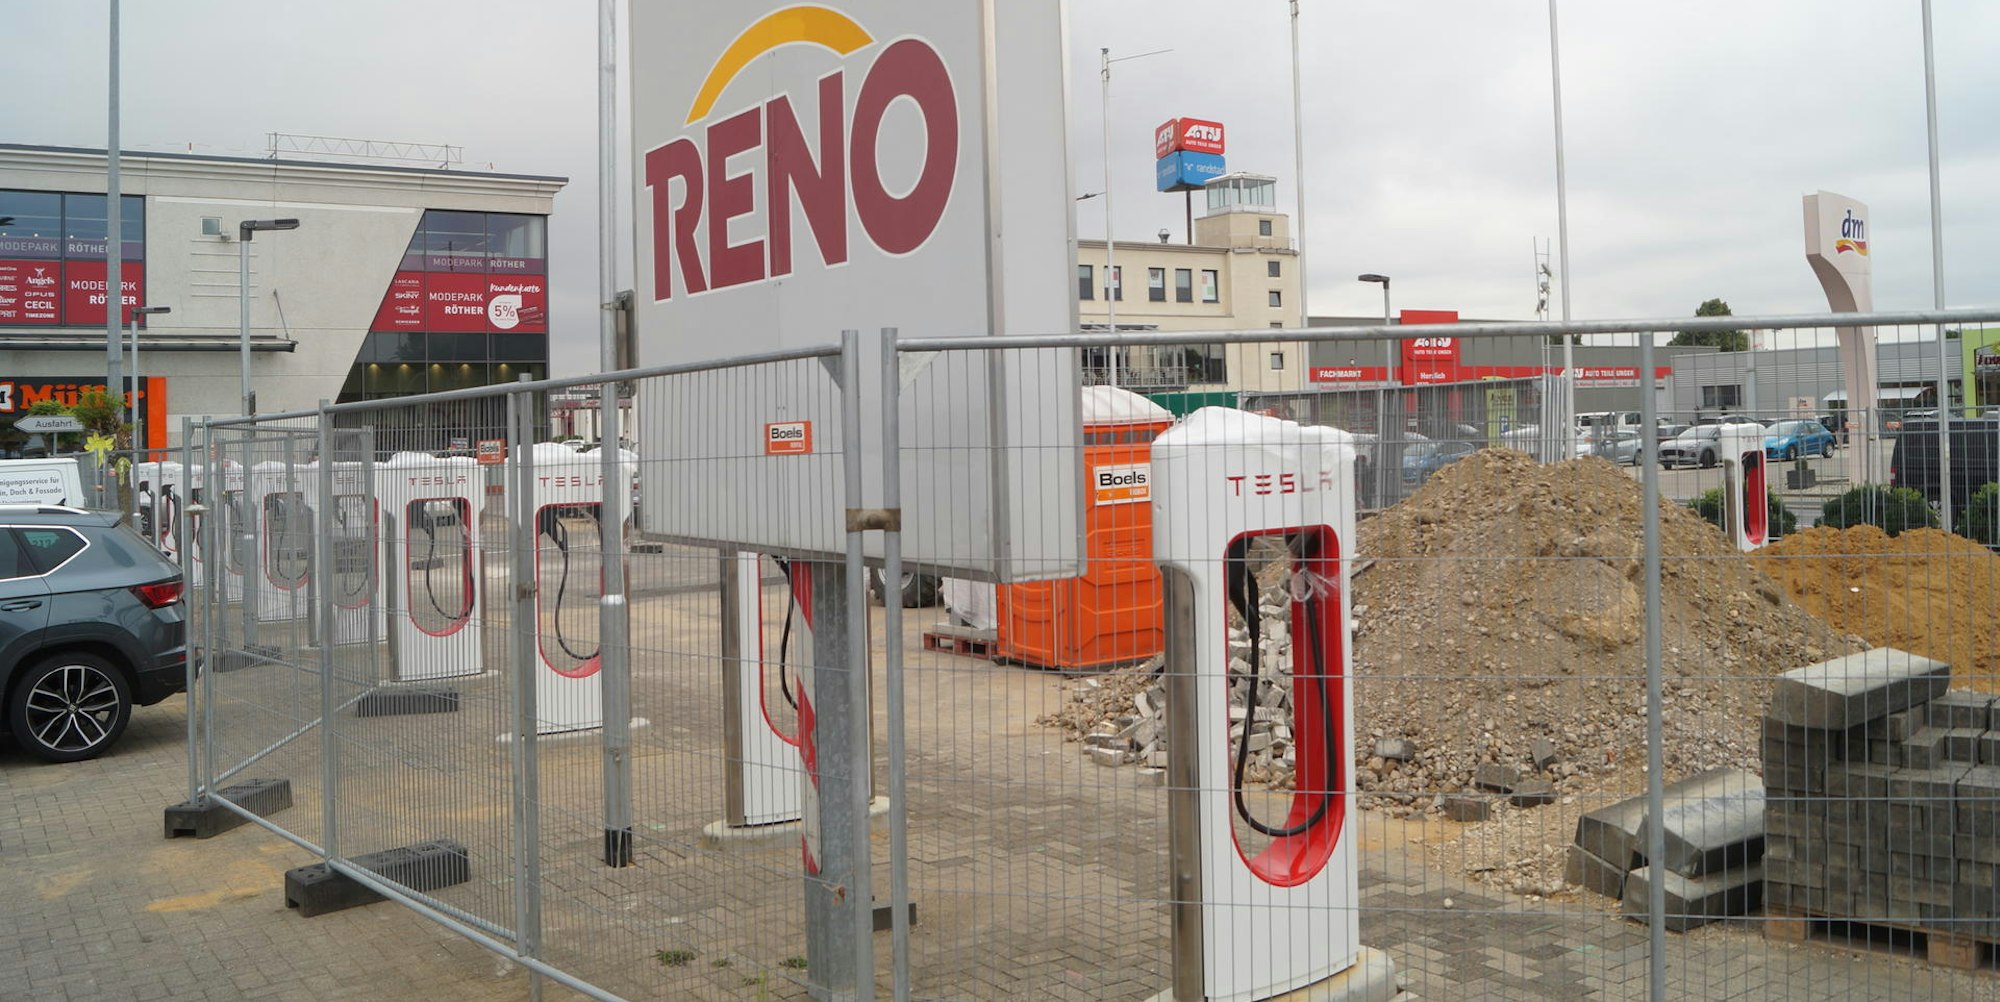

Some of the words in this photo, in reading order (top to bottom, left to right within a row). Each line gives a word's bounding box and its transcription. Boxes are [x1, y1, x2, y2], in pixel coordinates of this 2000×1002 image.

[1184, 125, 1222, 142] ATU
[645, 37, 959, 303] RENO
[1842, 209, 1864, 239] dm
[68, 242, 108, 253] RÖTHE
[433, 258, 483, 267] MODEPARK
[490, 258, 525, 269] RÖTHER
[429, 292, 483, 302] MODEPARK
[25, 300, 55, 309] CECIL
[444, 304, 484, 315] RÖTHER
[494, 304, 515, 318] 5%
[1319, 370, 1362, 379] FACHMARKT
[35, 420, 73, 429] Ausfahrt
[771, 427, 803, 439] Boels
[408, 475, 466, 486] TESLA
[538, 475, 604, 487] TESL
[1100, 471, 1146, 486] Boels
[1226, 470, 1332, 496] TESLA
